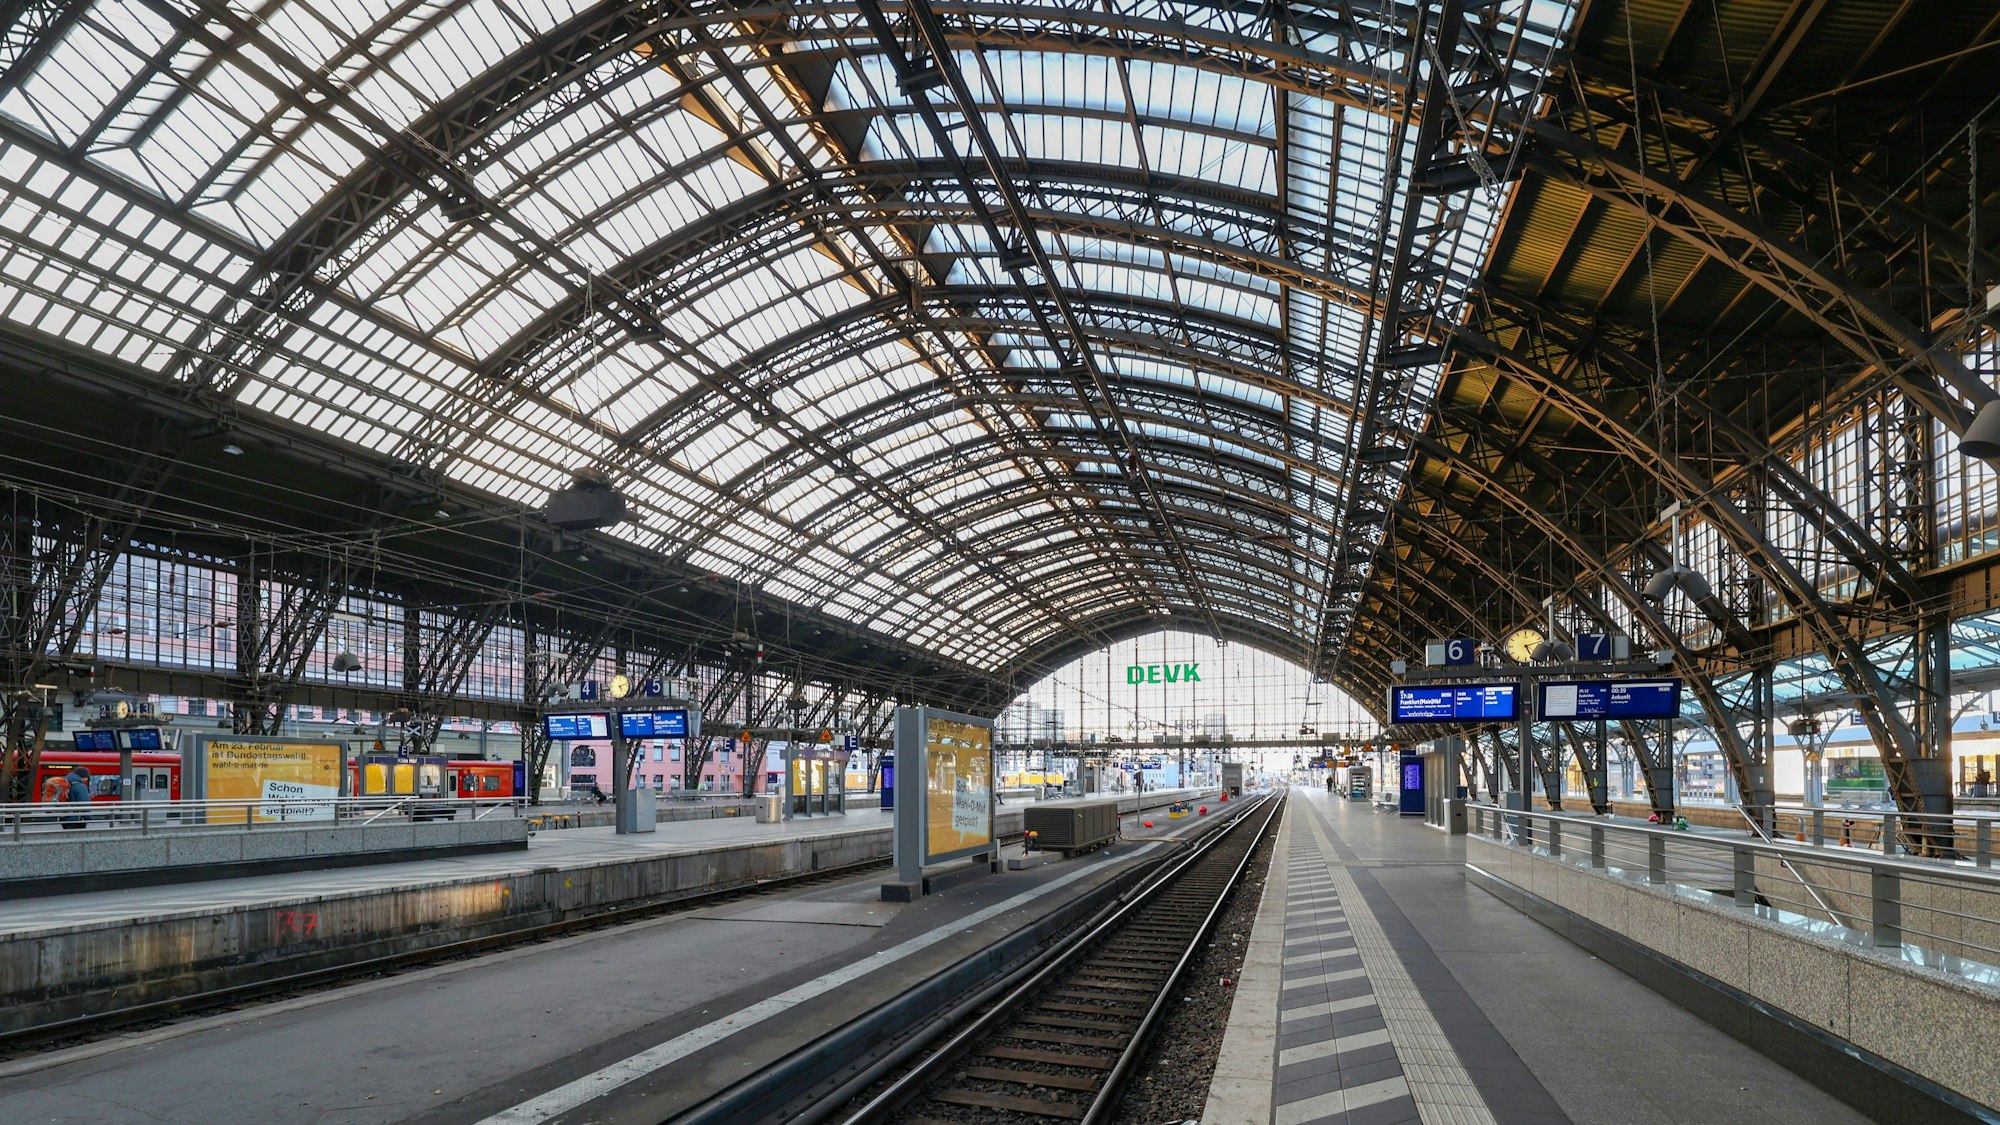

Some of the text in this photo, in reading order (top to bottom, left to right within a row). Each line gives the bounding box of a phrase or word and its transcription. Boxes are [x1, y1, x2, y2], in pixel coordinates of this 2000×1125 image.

[1448, 640, 1463, 660] 6
[1589, 634, 1605, 654] 7
[1127, 663, 1201, 684] DEVK
[582, 681, 590, 695] 4
[652, 680, 660, 693] 5
[101, 705, 106, 716] 2
[143, 704, 148, 714] 3
[1852, 714, 1861, 724] E
[211, 741, 229, 749] Am
[248, 743, 284, 751] Februar
[724, 739, 730, 749] E
[849, 735, 856, 748] E
[401, 745, 407, 756] E
[269, 782, 303, 794] Schon
[956, 796, 986, 814] Wahl-O-Mat
